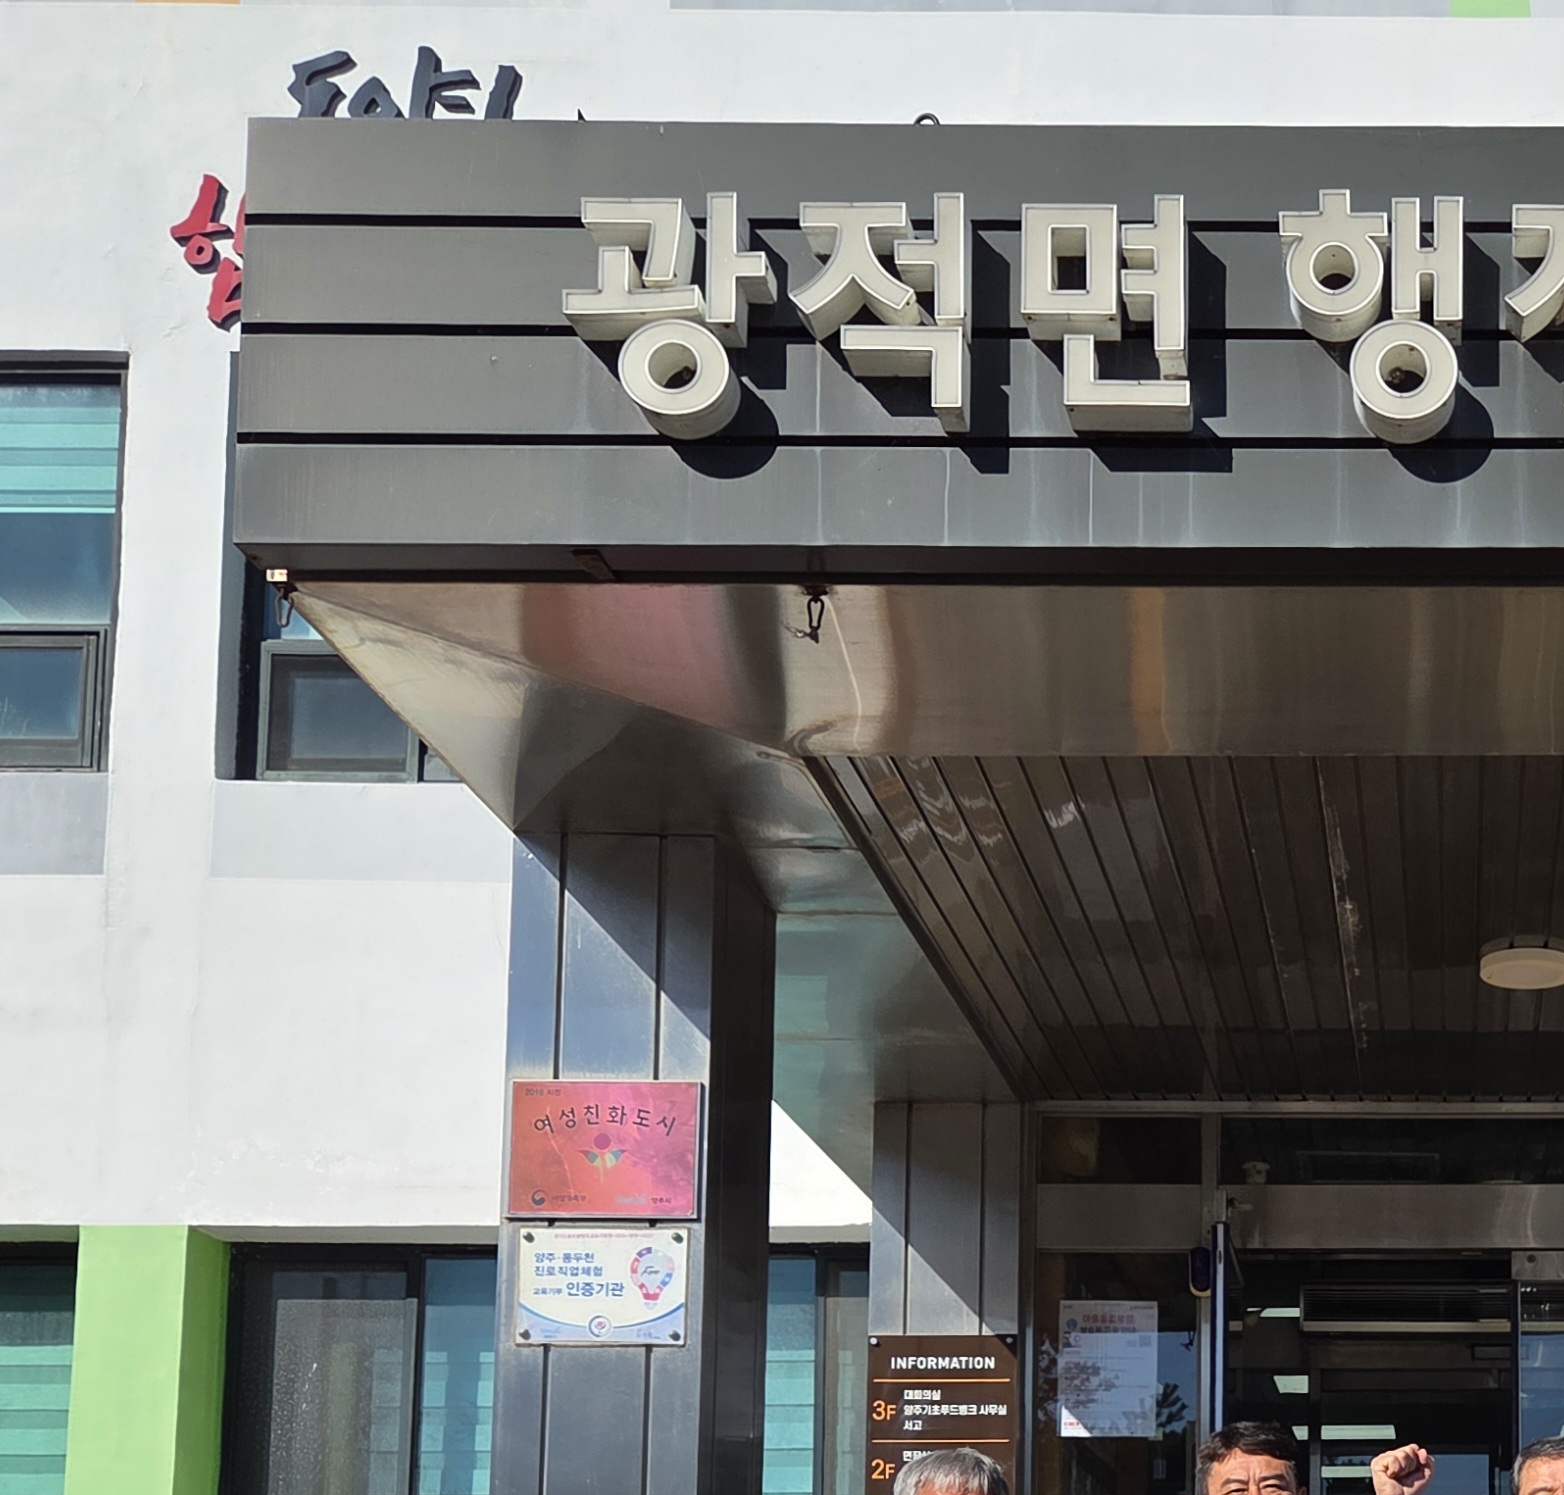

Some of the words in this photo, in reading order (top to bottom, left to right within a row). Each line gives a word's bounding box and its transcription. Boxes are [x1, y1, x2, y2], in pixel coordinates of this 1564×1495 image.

[562, 192, 1193, 440] 광적면
[534, 1104, 676, 1136] 여성친화도시
[566, 1282, 625, 1297] 인증기관
[891, 1357, 995, 1369] INFORMATION
[872, 1400, 897, 1420] 3F
[979, 1405, 1007, 1415] 사무실
[903, 1420, 922, 1430] 서고
[871, 1460, 895, 1479] 2F
